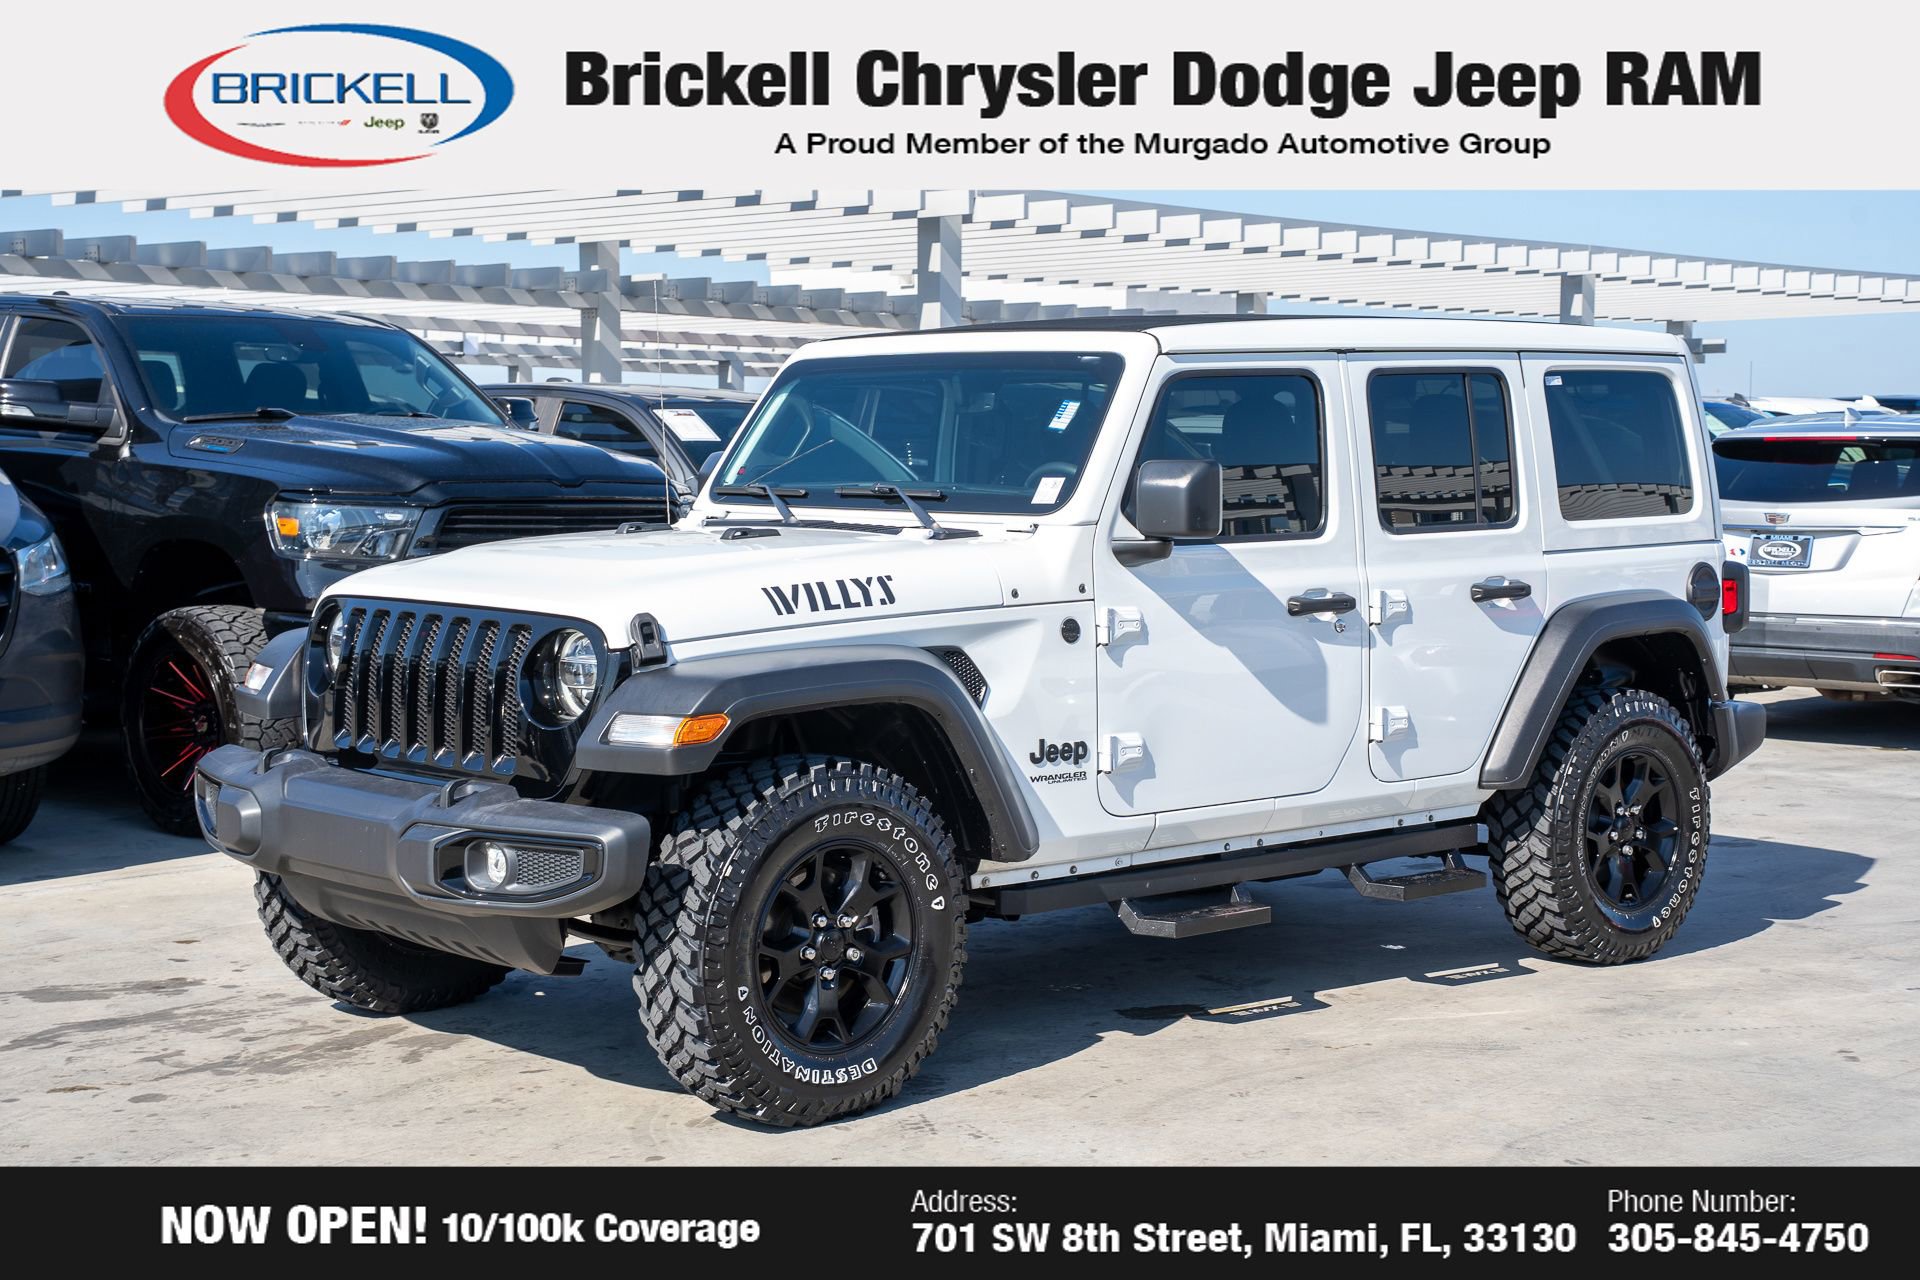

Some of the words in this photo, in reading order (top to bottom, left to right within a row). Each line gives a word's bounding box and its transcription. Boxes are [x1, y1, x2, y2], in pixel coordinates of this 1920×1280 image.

[761, 575, 895, 615] WILLYS
[1029, 739, 1088, 765] Jeep
[1030, 771, 1087, 783] WRANGLER
[1047, 777, 1087, 785] UNLIMITED
[814, 811, 939, 891] Firestone
[1660, 787, 1701, 919] Firestone
[743, 1006, 878, 1085] DESTINATION
